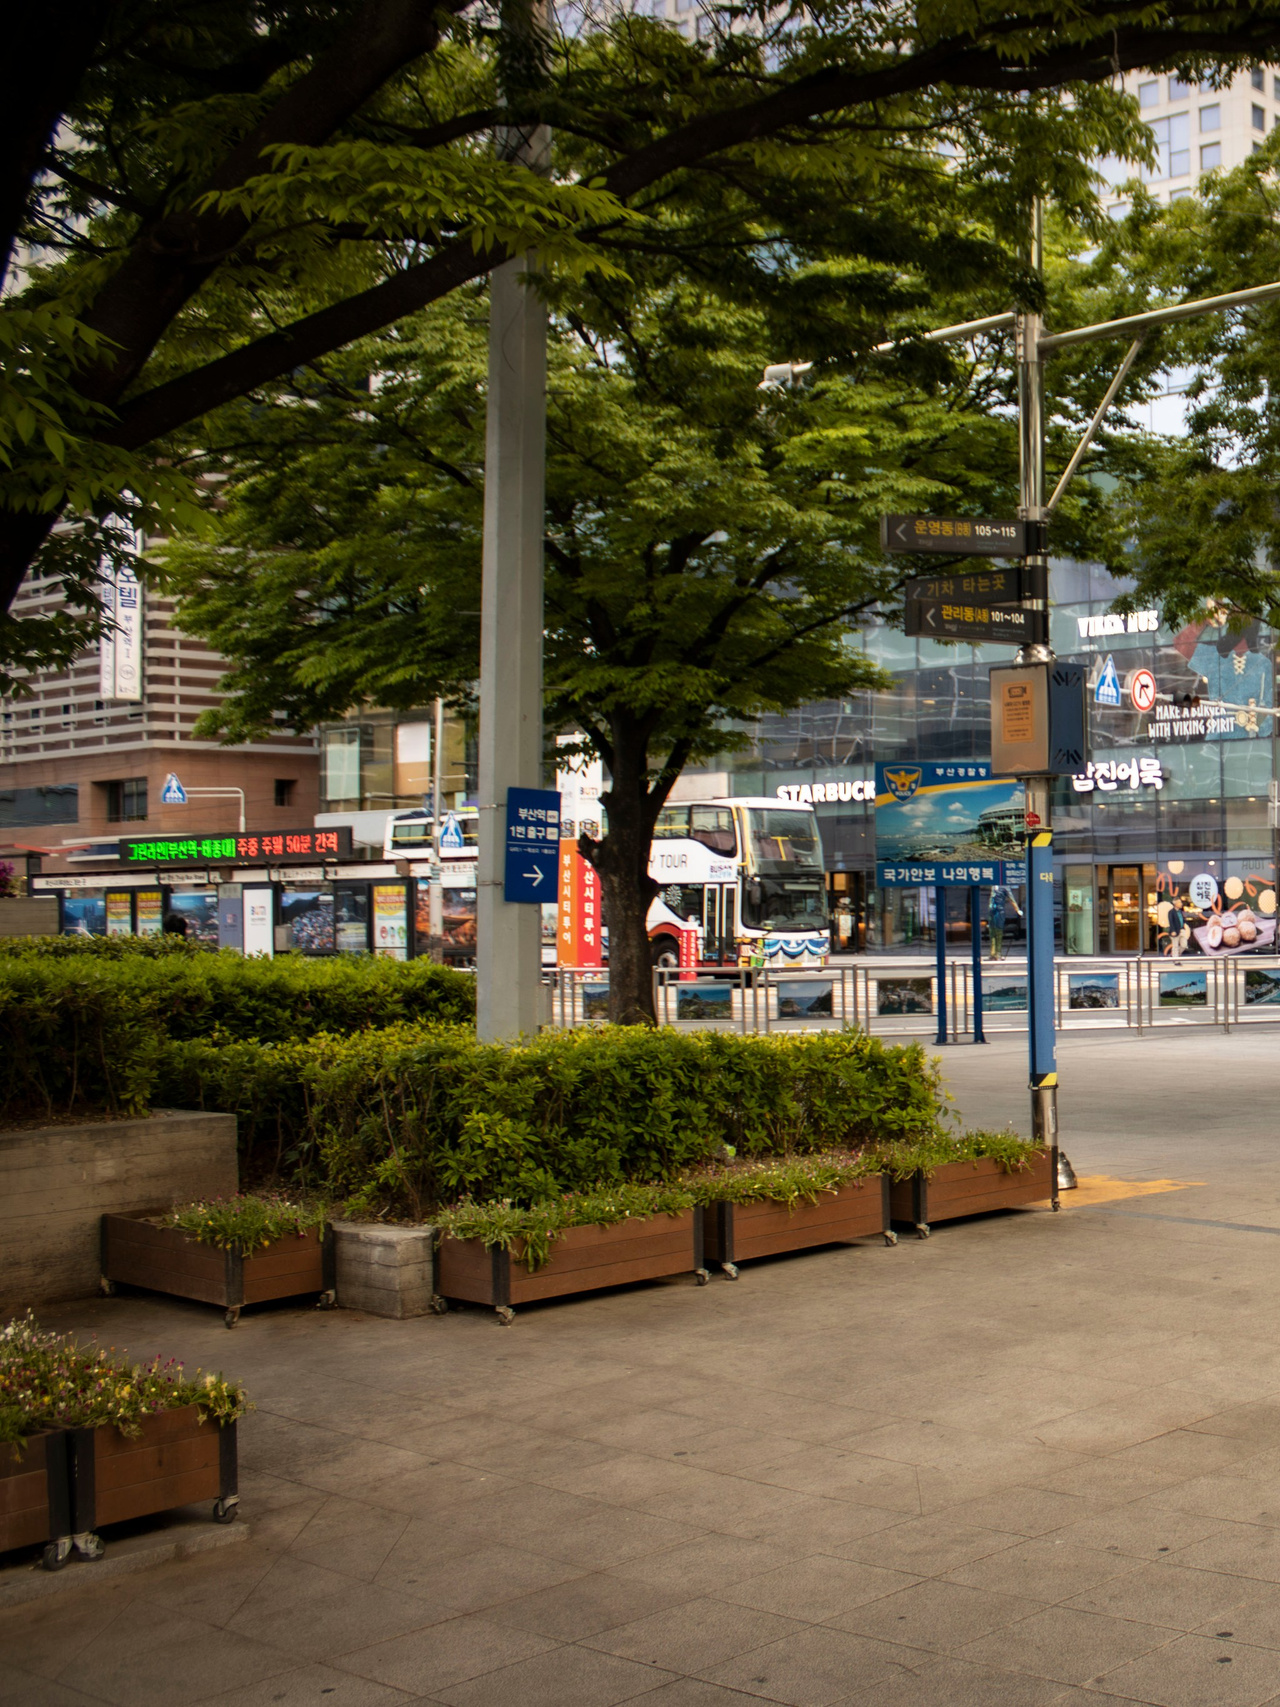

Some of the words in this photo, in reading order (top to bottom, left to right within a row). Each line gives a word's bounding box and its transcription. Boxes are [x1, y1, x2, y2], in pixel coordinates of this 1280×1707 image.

[974, 524, 1017, 538] 105~115
[927, 580, 955, 597] 기차
[962, 573, 1007, 593] 타는곳
[991, 611, 1025, 624] 101~104
[1156, 704, 1181, 721] MAKE
[1182, 706, 1190, 719] A
[1148, 722, 1171, 739] WITH
[1173, 719, 1205, 737] VIKING
[1206, 717, 1236, 735] SPIRIT
[1071, 757, 1164, 792] 삼진어묵
[776, 781, 876, 804] STARBUCK
[518, 807, 546, 822] 부산역
[509, 825, 526, 839] 1번
[526, 826, 546, 840] 출구
[237, 837, 259, 858] 주중
[261, 834, 284, 856] 주말
[285, 834, 312, 854] 50분
[314, 831, 339, 853] 간격
[659, 853, 688, 869] TOUR
[882, 867, 937, 883] 국가안보
[942, 867, 995, 882] 나의행복
[562, 854, 572, 945] 부산시티투어
